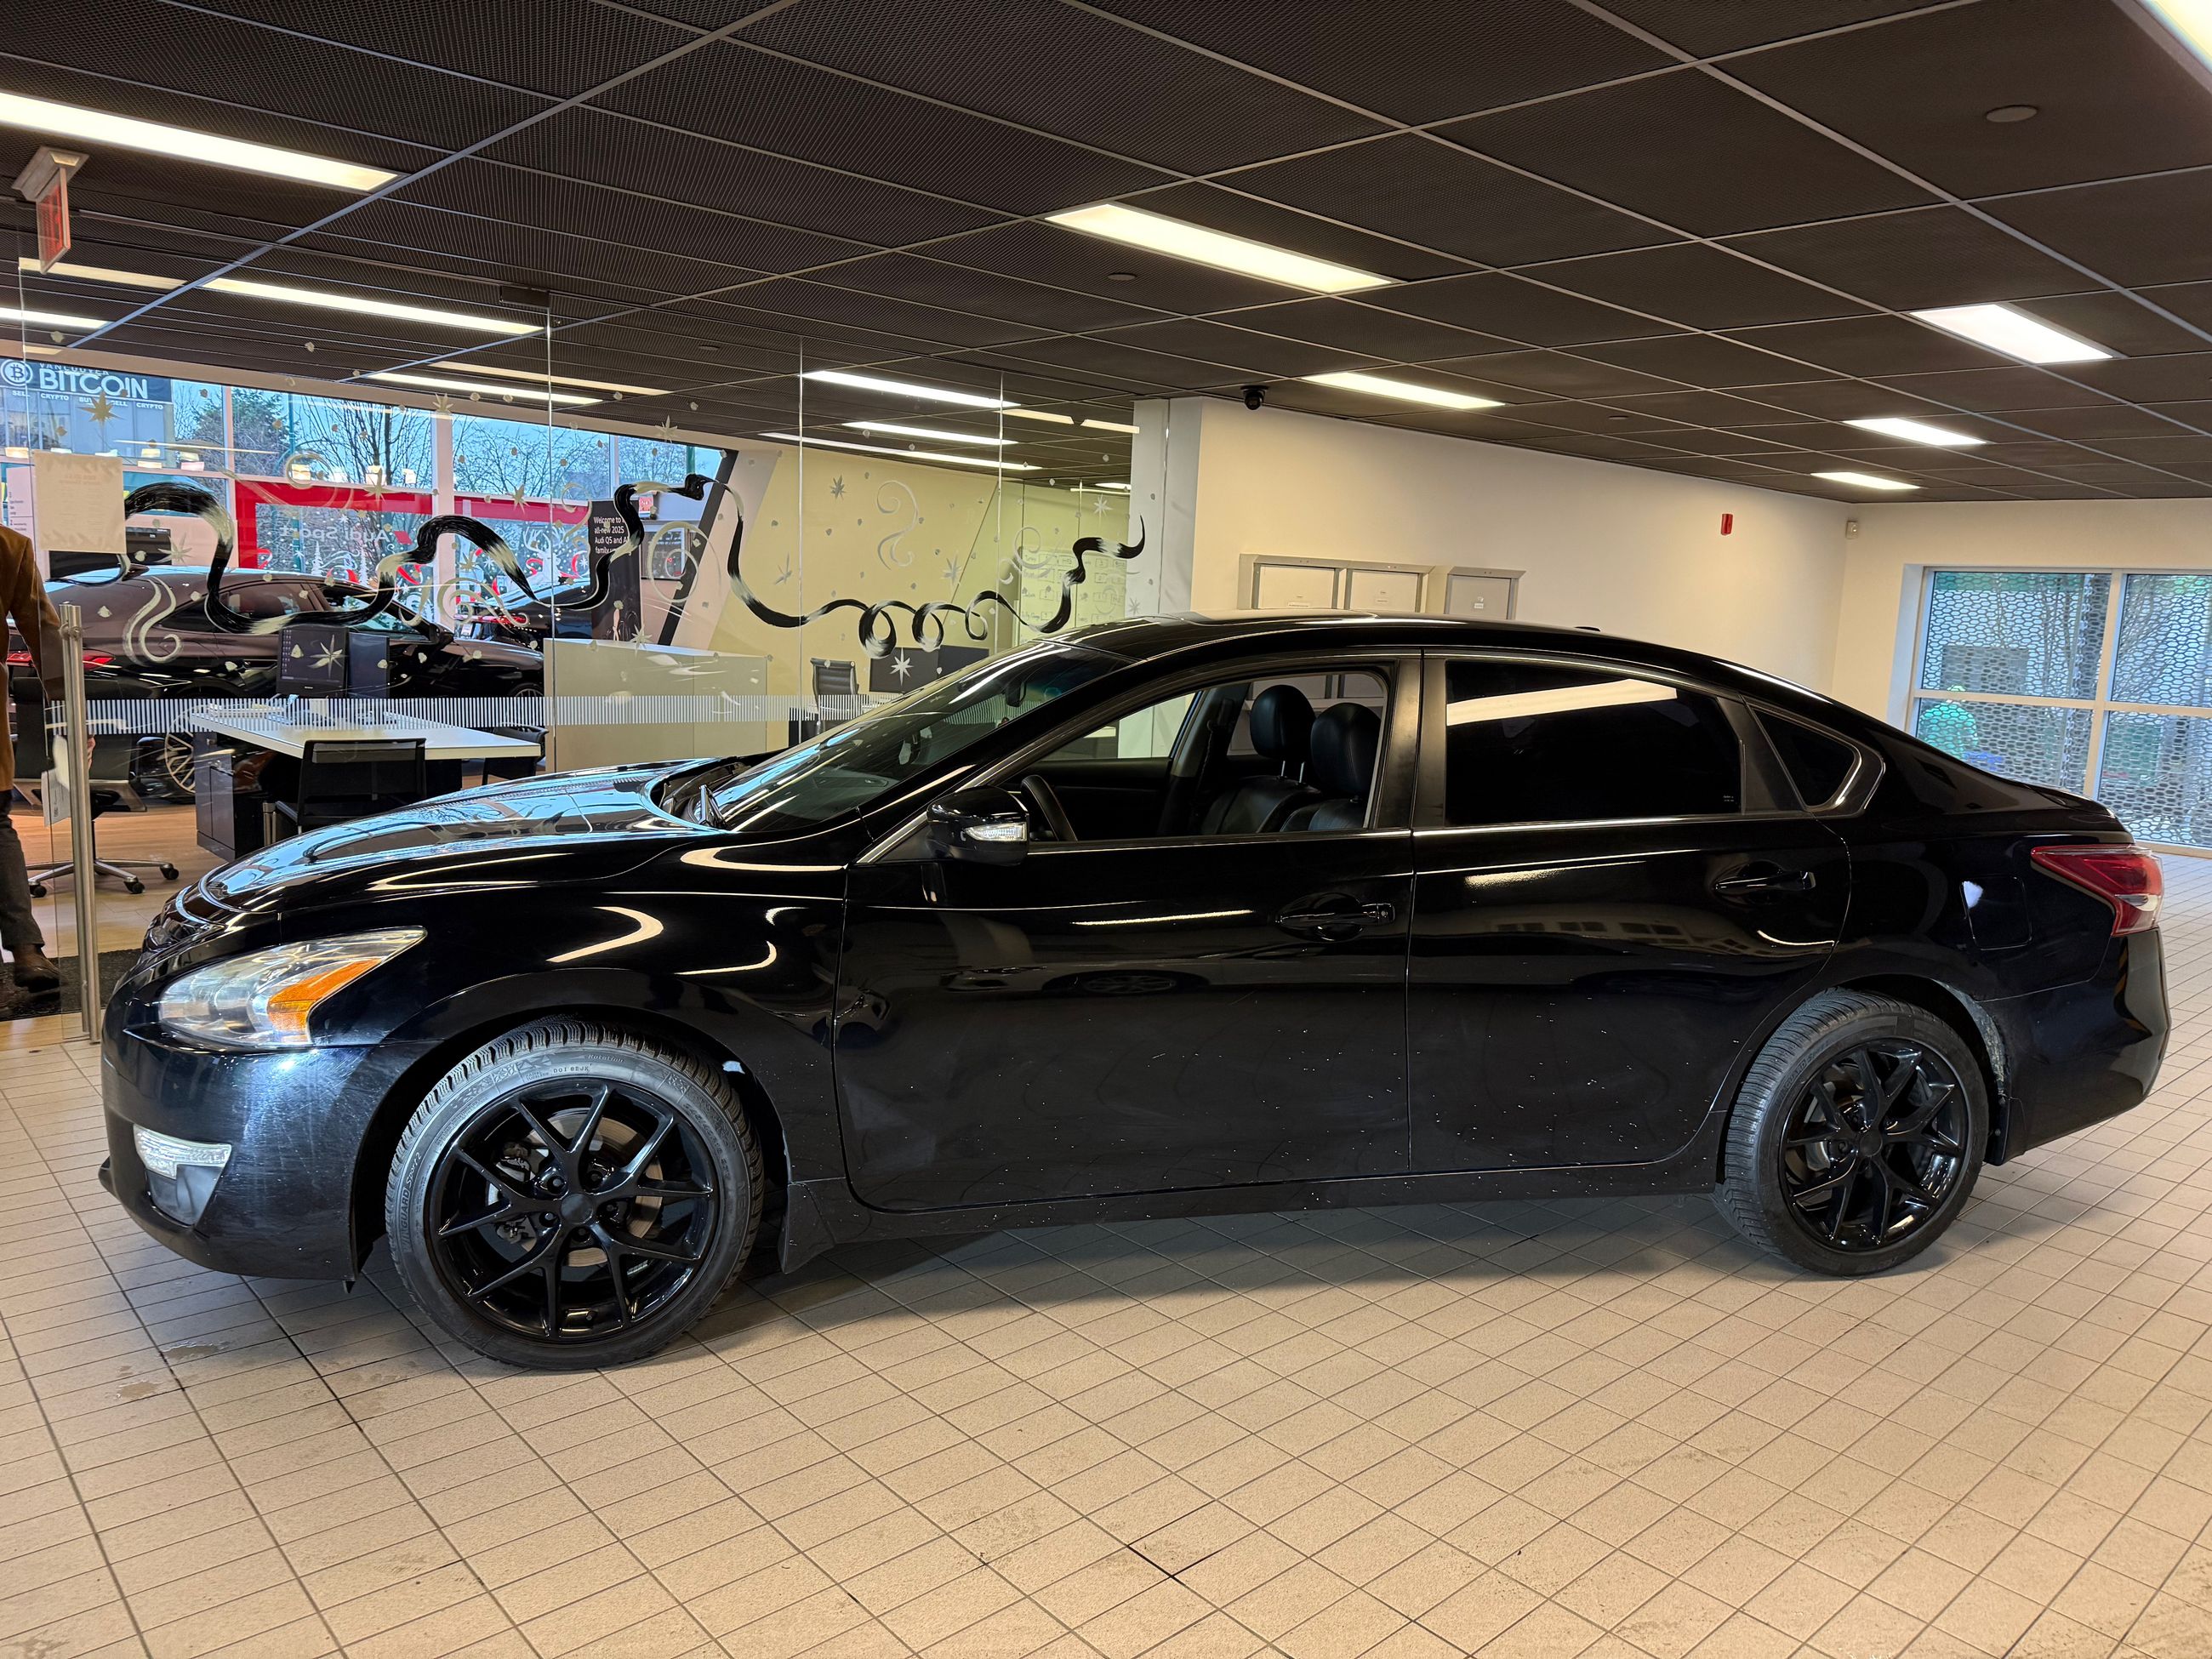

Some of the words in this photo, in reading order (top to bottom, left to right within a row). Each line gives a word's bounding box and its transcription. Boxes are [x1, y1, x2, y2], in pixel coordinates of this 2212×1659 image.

[39, 368, 147, 399] BITCOIN
[136, 402, 164, 410] CRYPTO
[406, 1158, 418, 1188] Sport
